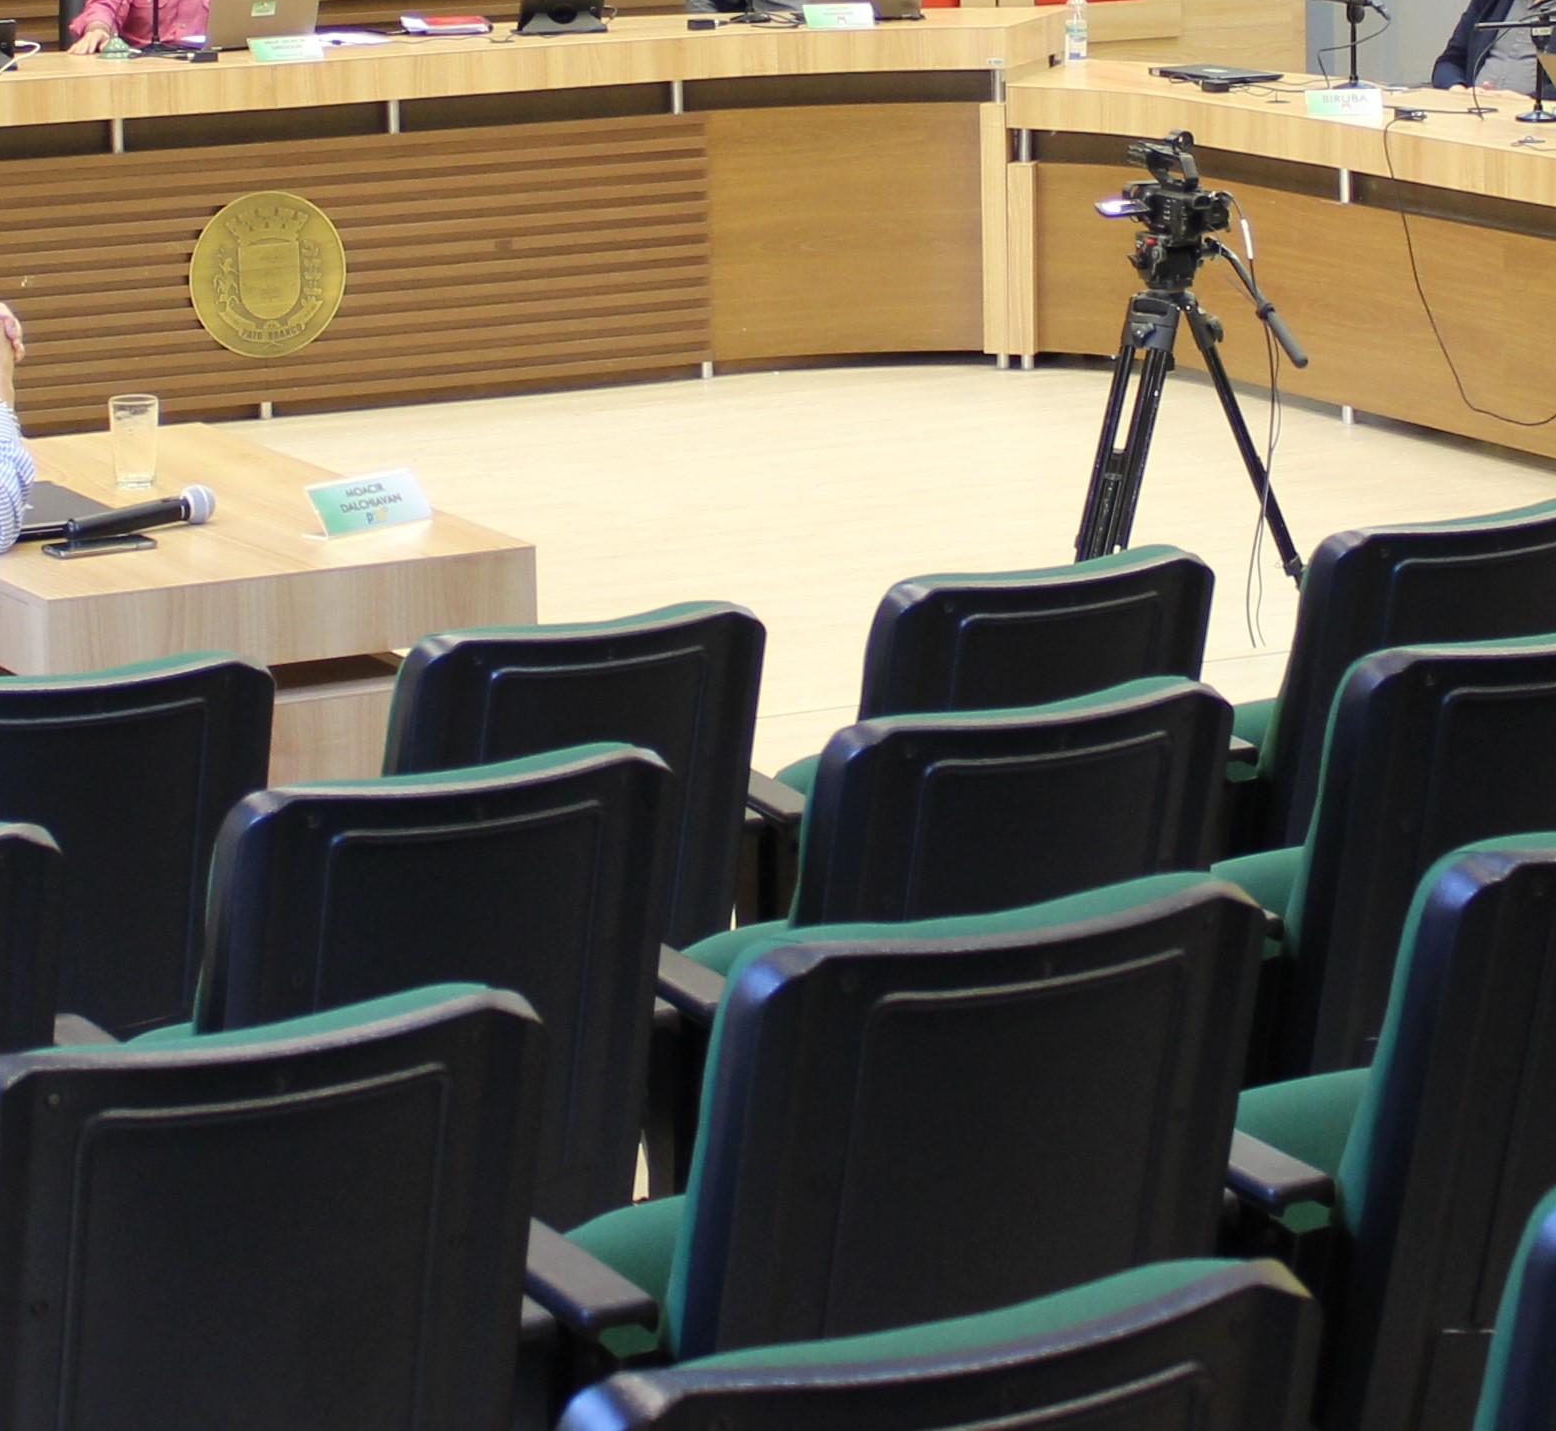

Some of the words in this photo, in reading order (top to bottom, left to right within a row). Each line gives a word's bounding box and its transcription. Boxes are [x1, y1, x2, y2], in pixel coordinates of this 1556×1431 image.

[1323, 94, 1368, 103] BIRUBA
[267, 323, 302, 341] BRANCO
[345, 483, 385, 498] MOACIR
[339, 493, 403, 513] DALCHIAVAN
